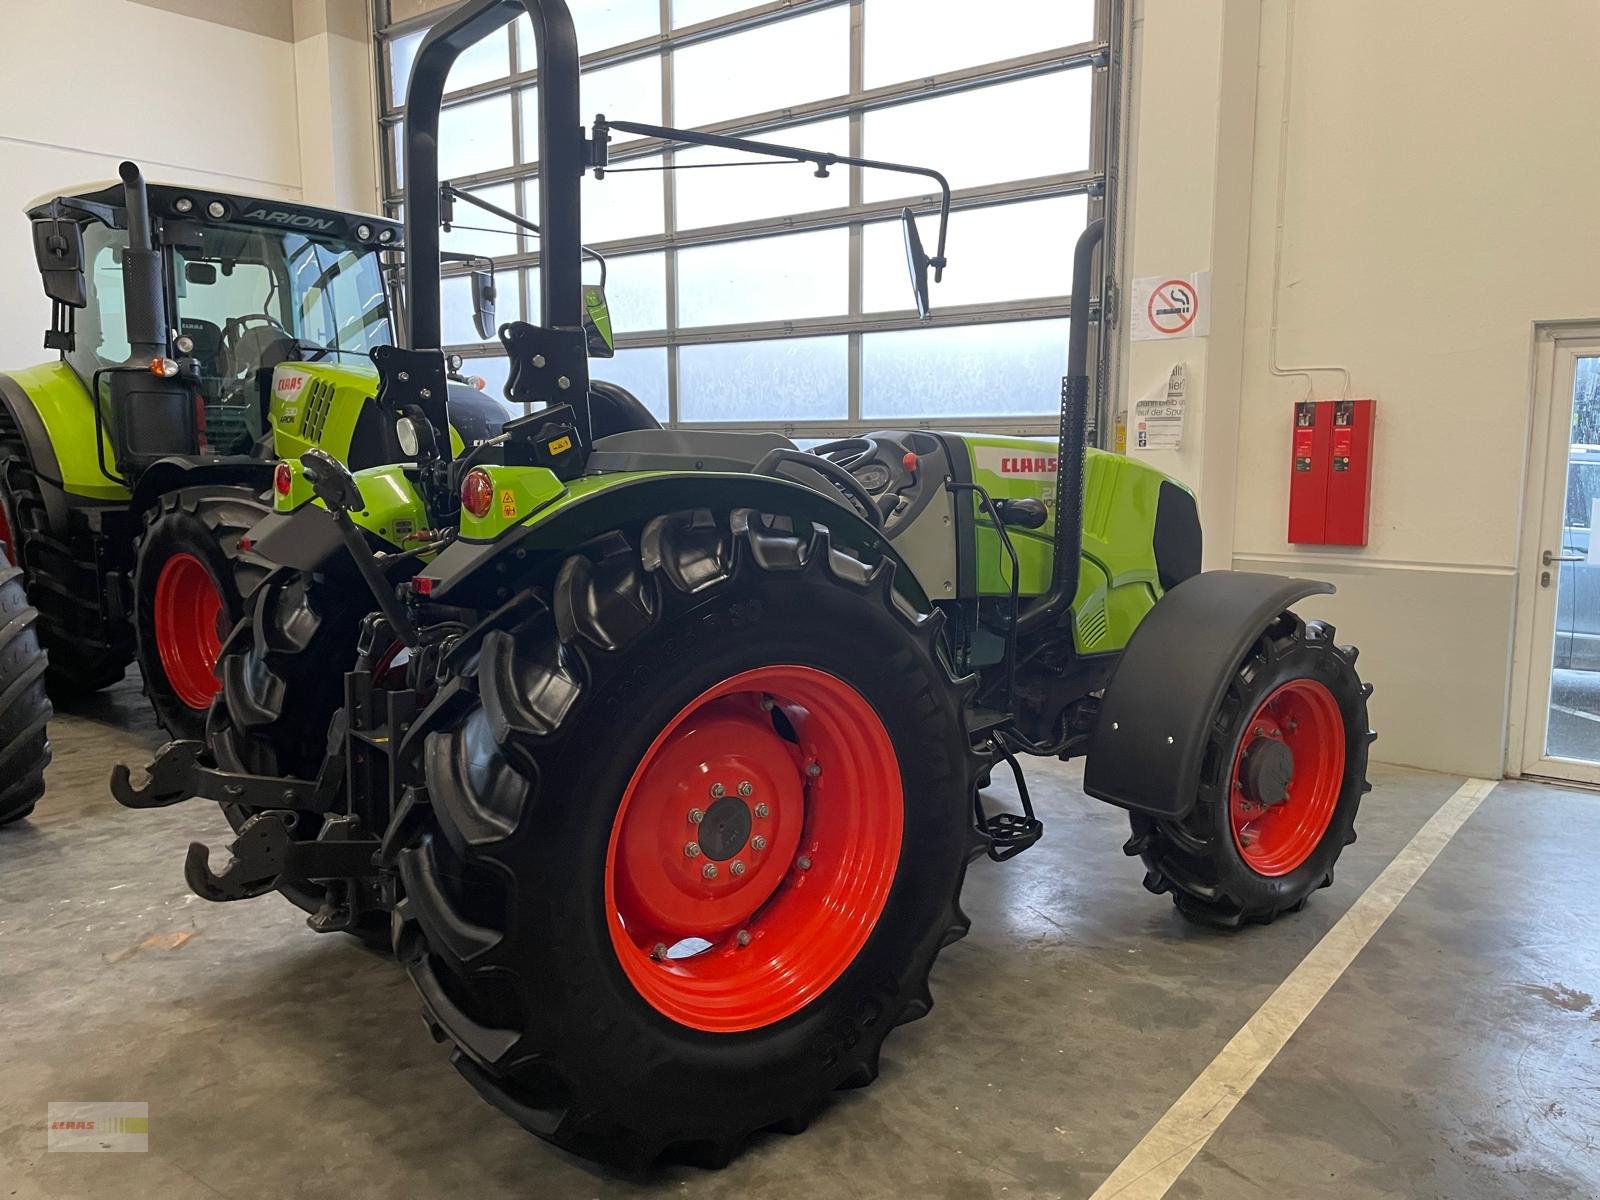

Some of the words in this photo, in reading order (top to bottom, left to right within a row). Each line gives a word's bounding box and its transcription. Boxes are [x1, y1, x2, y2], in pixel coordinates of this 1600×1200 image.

[244, 209, 335, 230] ARION
[277, 376, 303, 391] CLAAS
[1001, 458, 1057, 473] CLAAS
